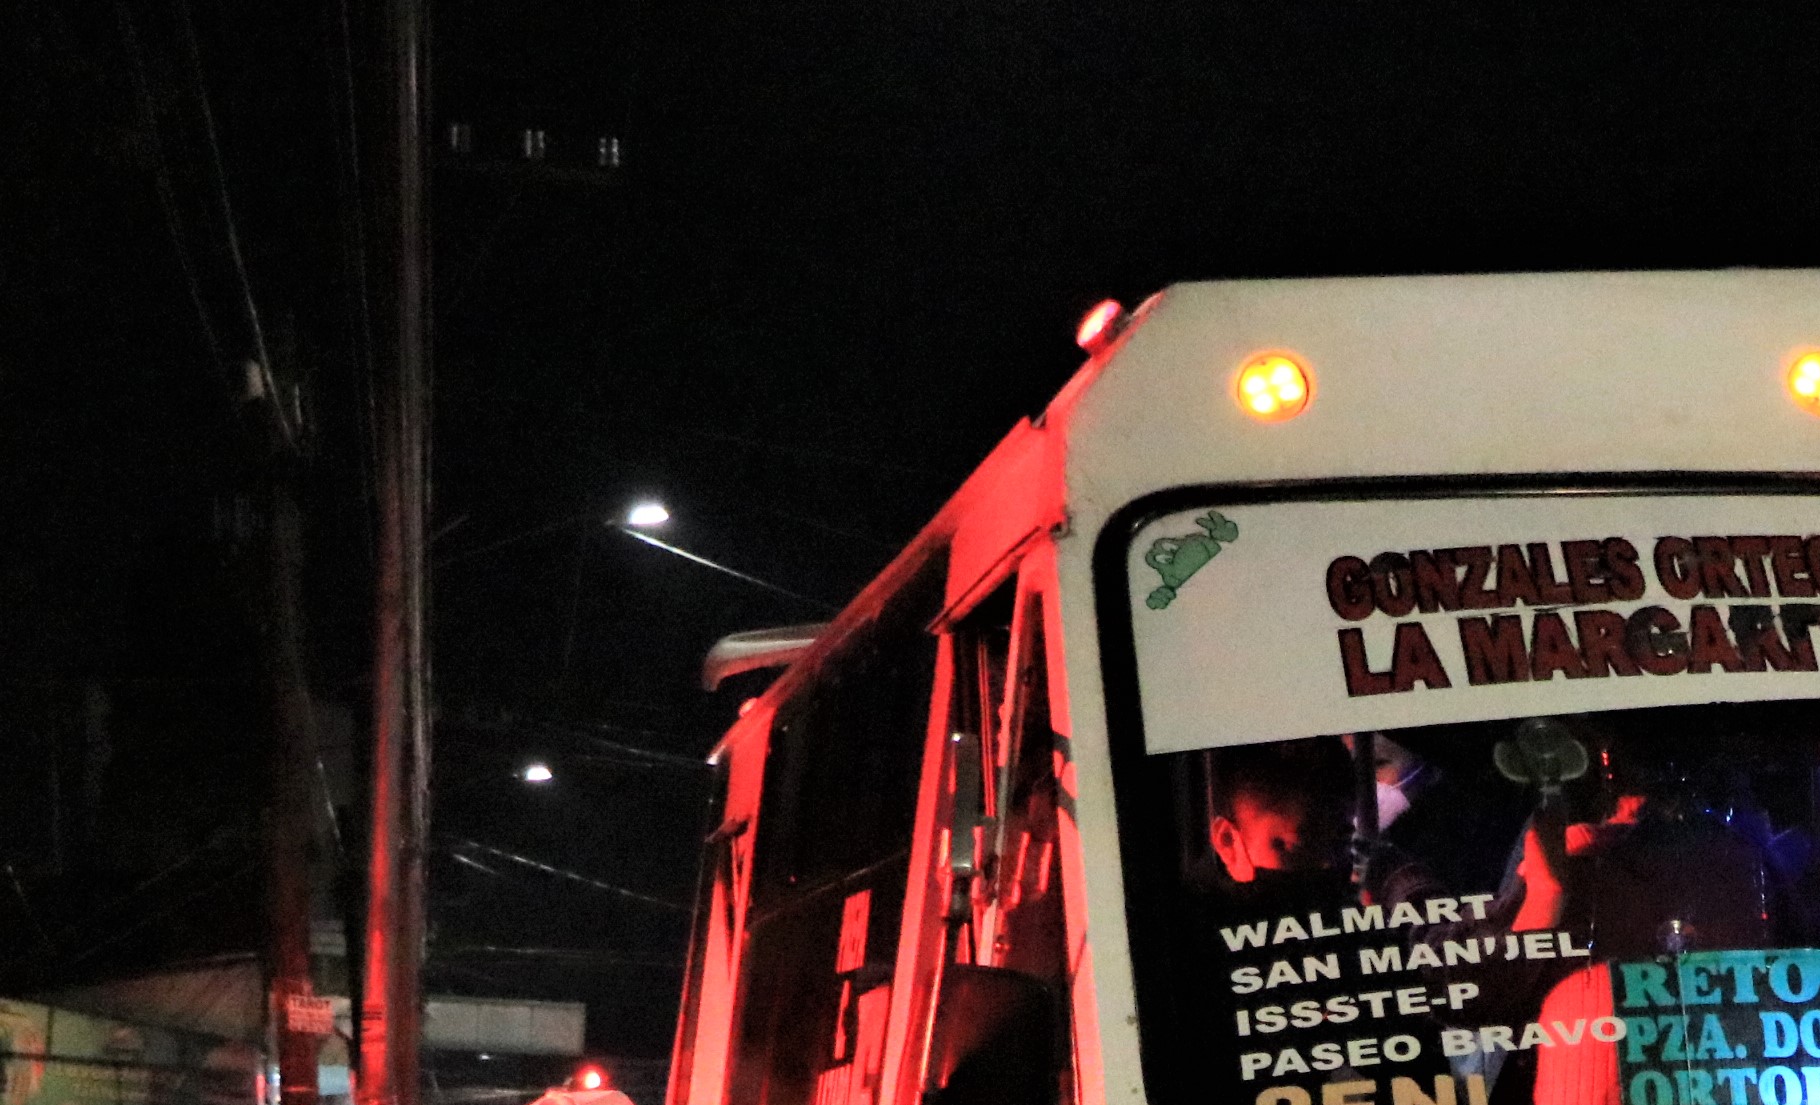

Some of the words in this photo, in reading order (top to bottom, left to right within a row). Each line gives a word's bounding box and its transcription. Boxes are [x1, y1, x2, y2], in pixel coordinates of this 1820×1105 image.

[1326, 537, 1646, 621] GONZALES
[1338, 621, 1452, 697] LA
[1220, 893, 1494, 953] WALMART
[1230, 952, 1341, 996] SAN
[1236, 982, 1480, 1038] ISSSTE-P
[1626, 1013, 1746, 1062] PZA.
[1240, 1034, 1422, 1082] PASEO
[1441, 1016, 1628, 1059] BRAVO
